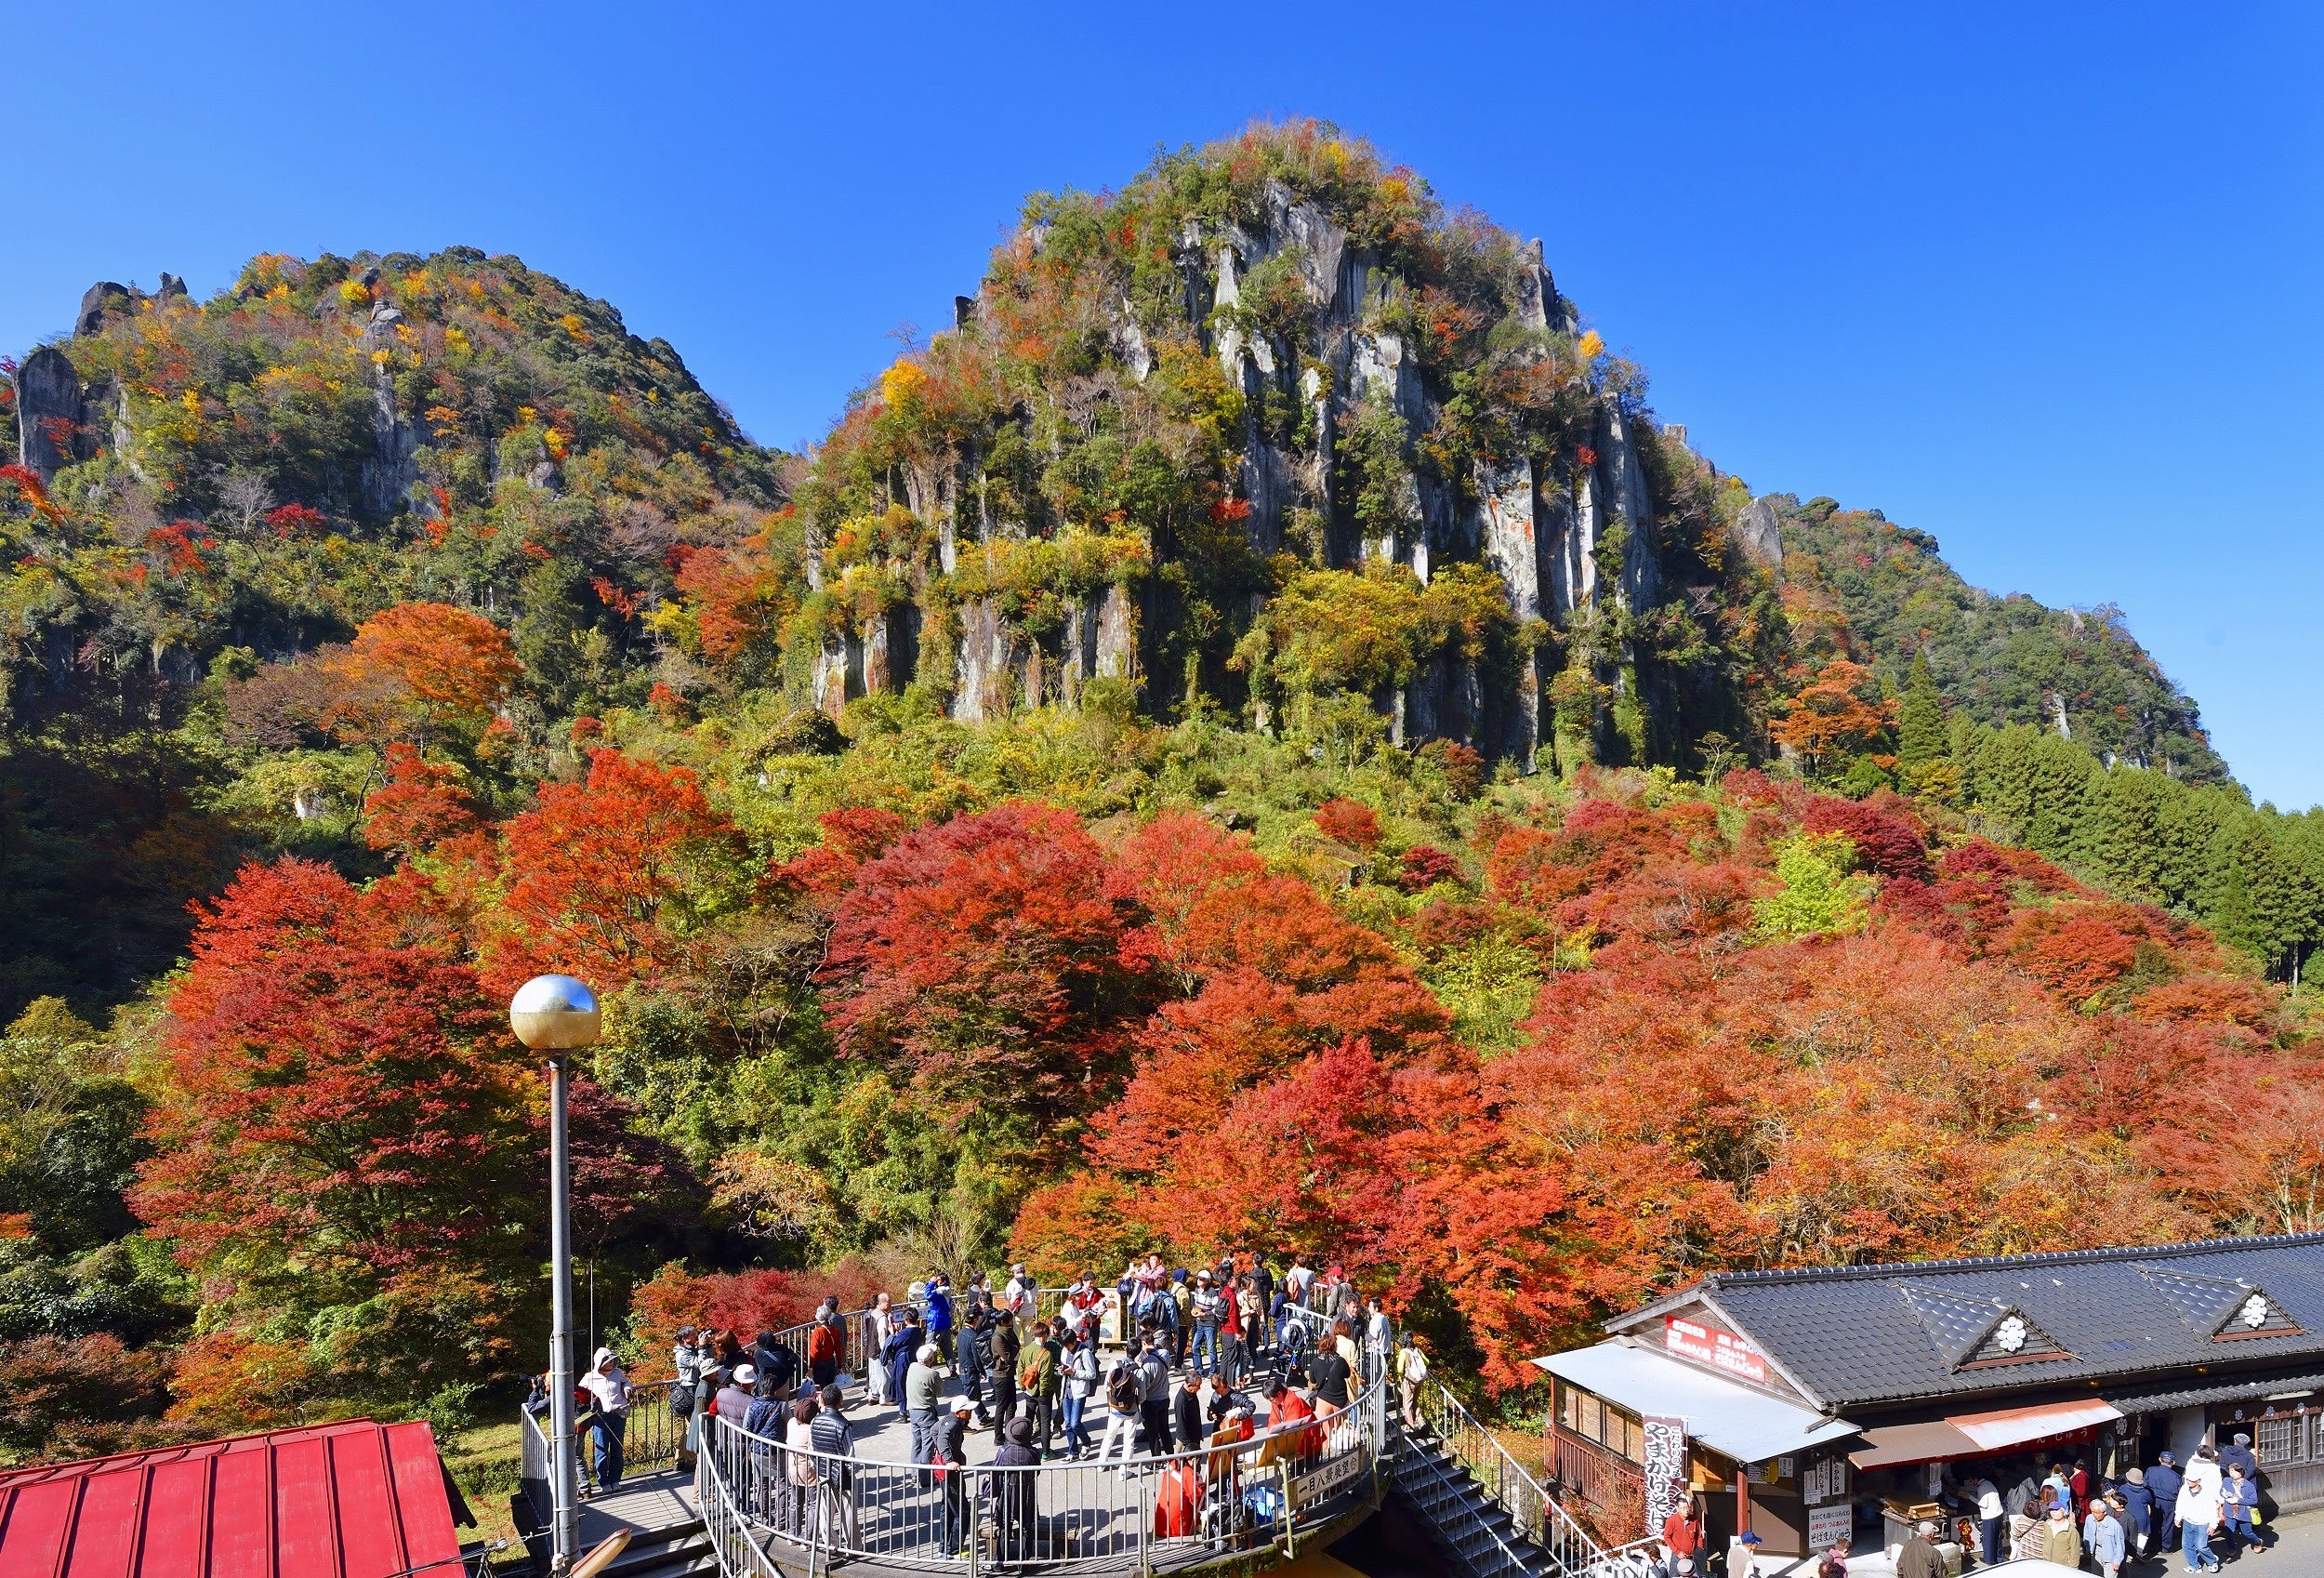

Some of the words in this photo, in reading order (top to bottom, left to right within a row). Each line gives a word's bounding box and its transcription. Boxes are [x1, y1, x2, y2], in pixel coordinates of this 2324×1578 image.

[1299, 1456, 1357, 1494] 一目八景展望台
[1810, 1528, 1851, 1544] そばまんじゅう
